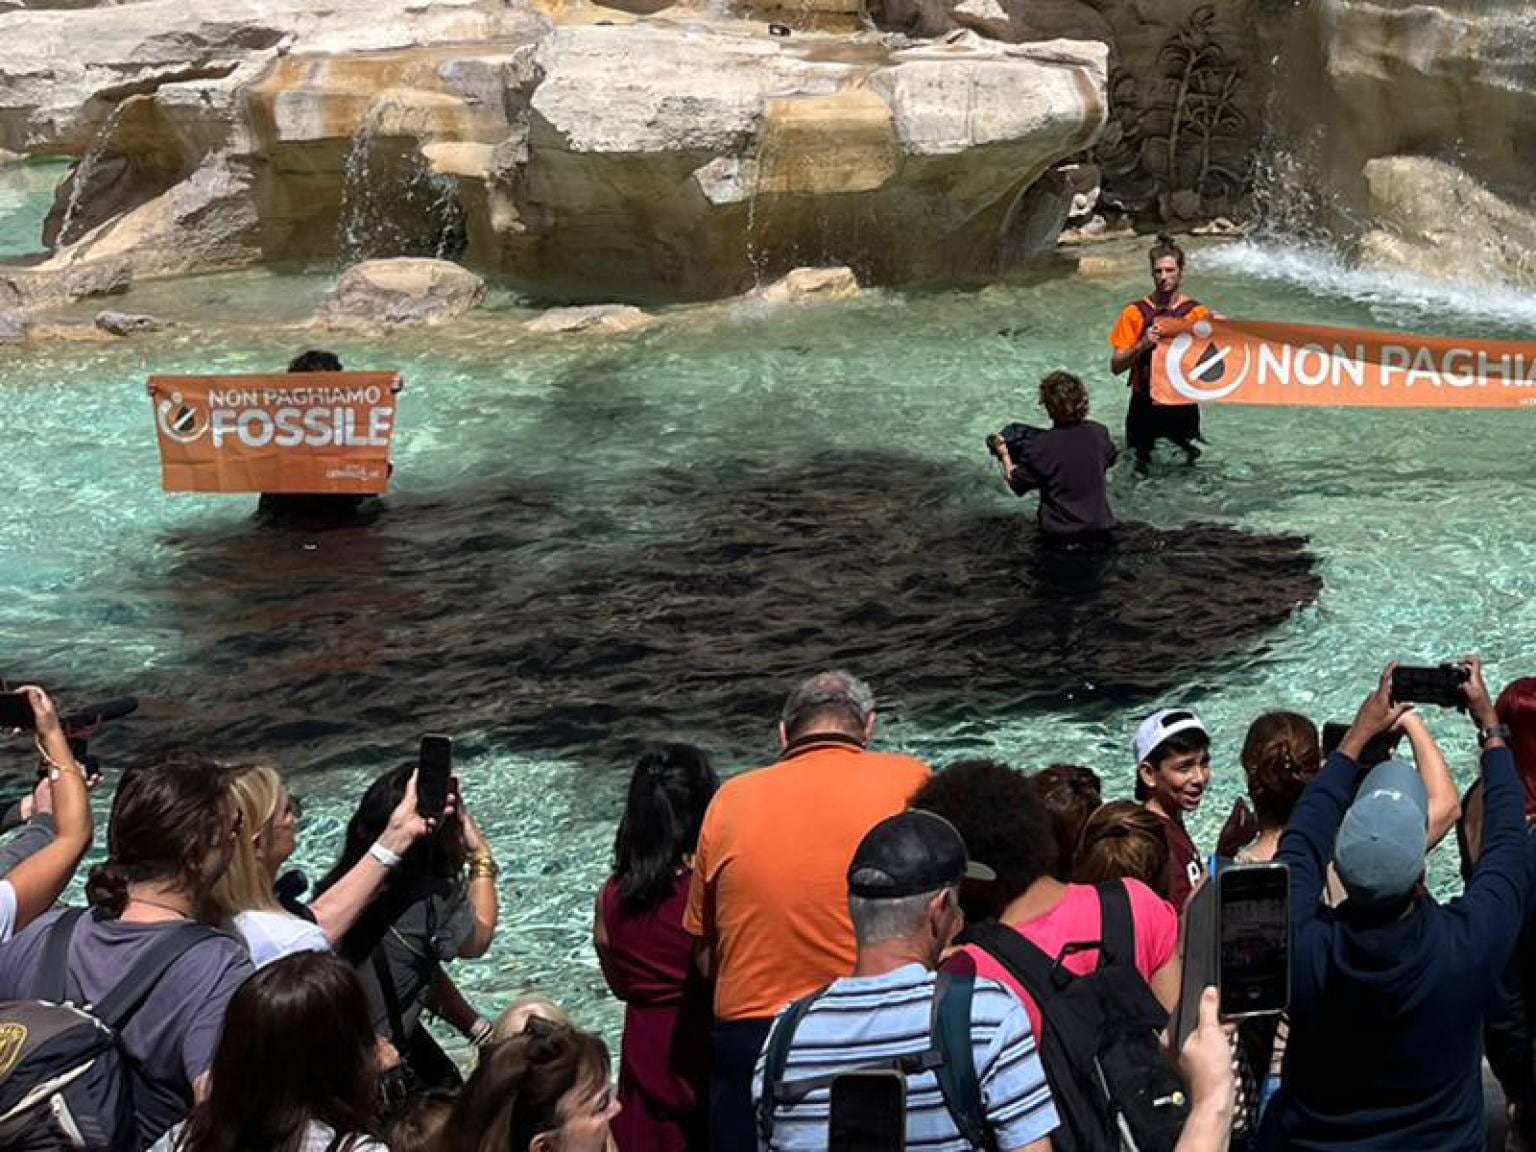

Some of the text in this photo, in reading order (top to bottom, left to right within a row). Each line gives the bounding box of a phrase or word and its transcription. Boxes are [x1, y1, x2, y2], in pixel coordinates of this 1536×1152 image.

[1256, 341, 1367, 386] NON
[208, 388, 259, 407] NON
[263, 385, 382, 406] PAGHIAMO
[211, 407, 393, 448] FOSSILE
